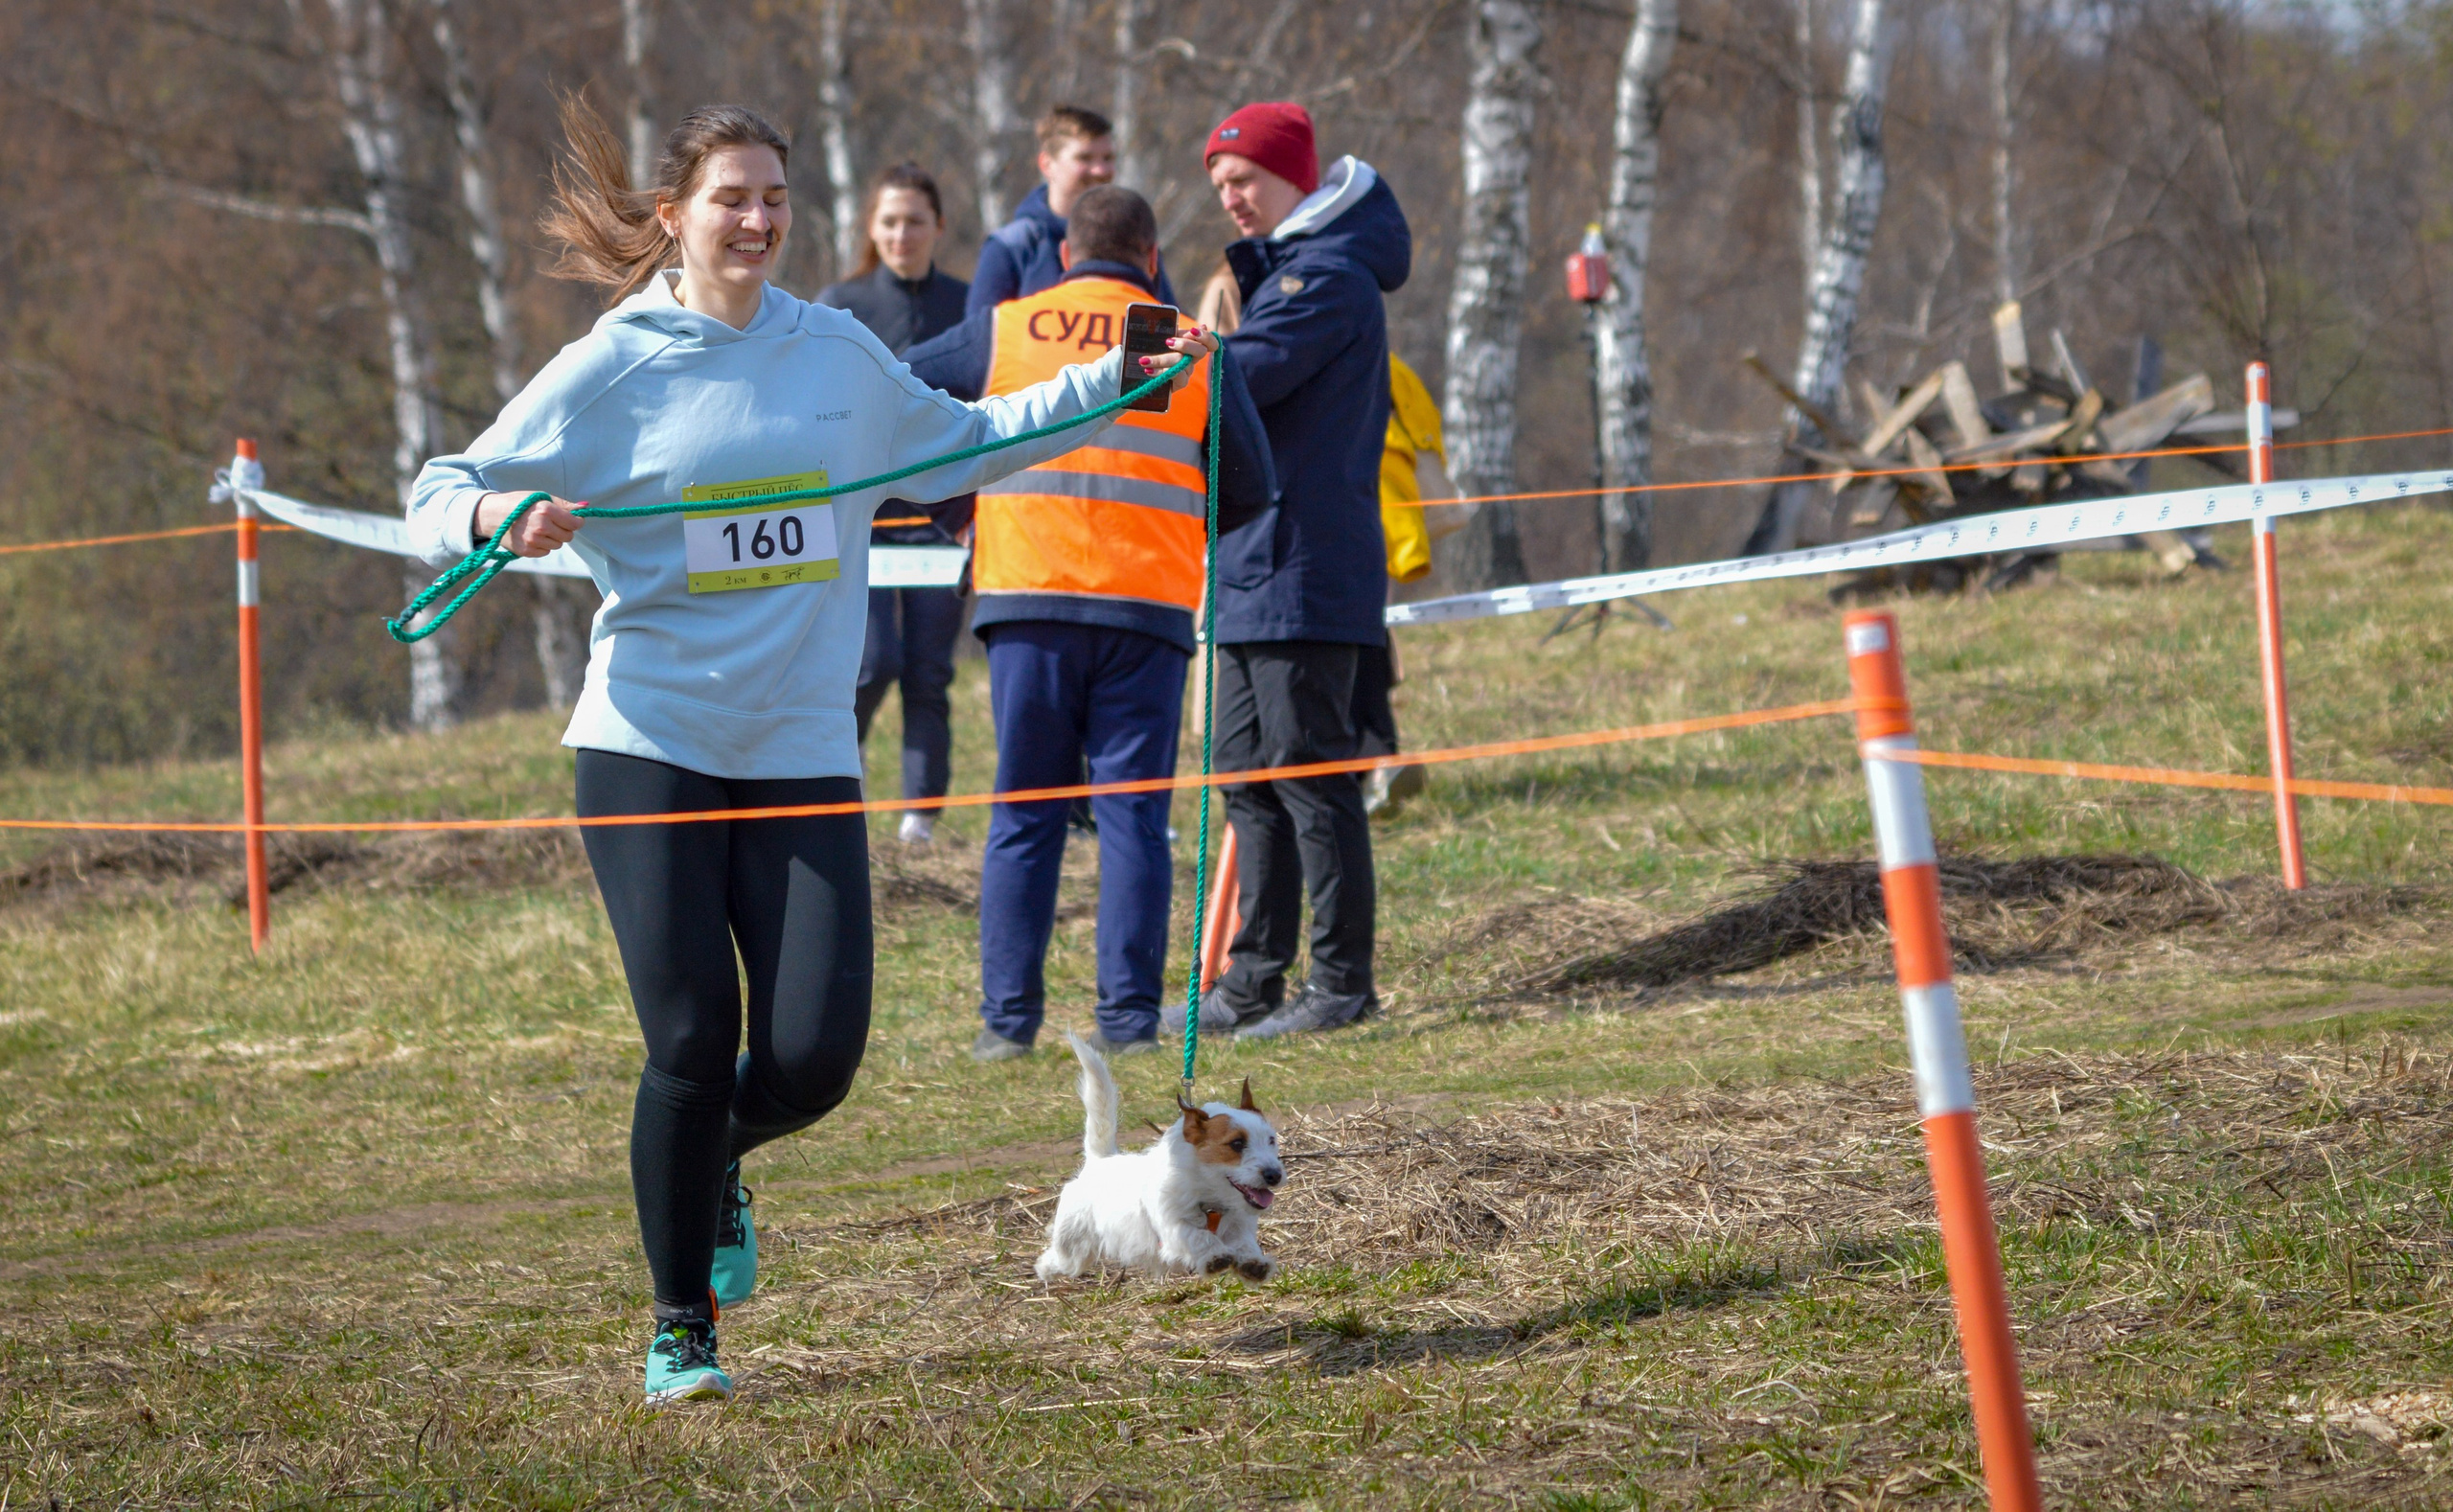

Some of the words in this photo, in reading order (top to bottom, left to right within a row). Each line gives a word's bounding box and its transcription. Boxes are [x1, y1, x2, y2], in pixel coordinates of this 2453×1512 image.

[1028, 309, 1127, 351] СУД
[815, 410, 852, 422] РАССВЕТ
[722, 515, 804, 562] 160
[725, 576, 732, 585] 2
